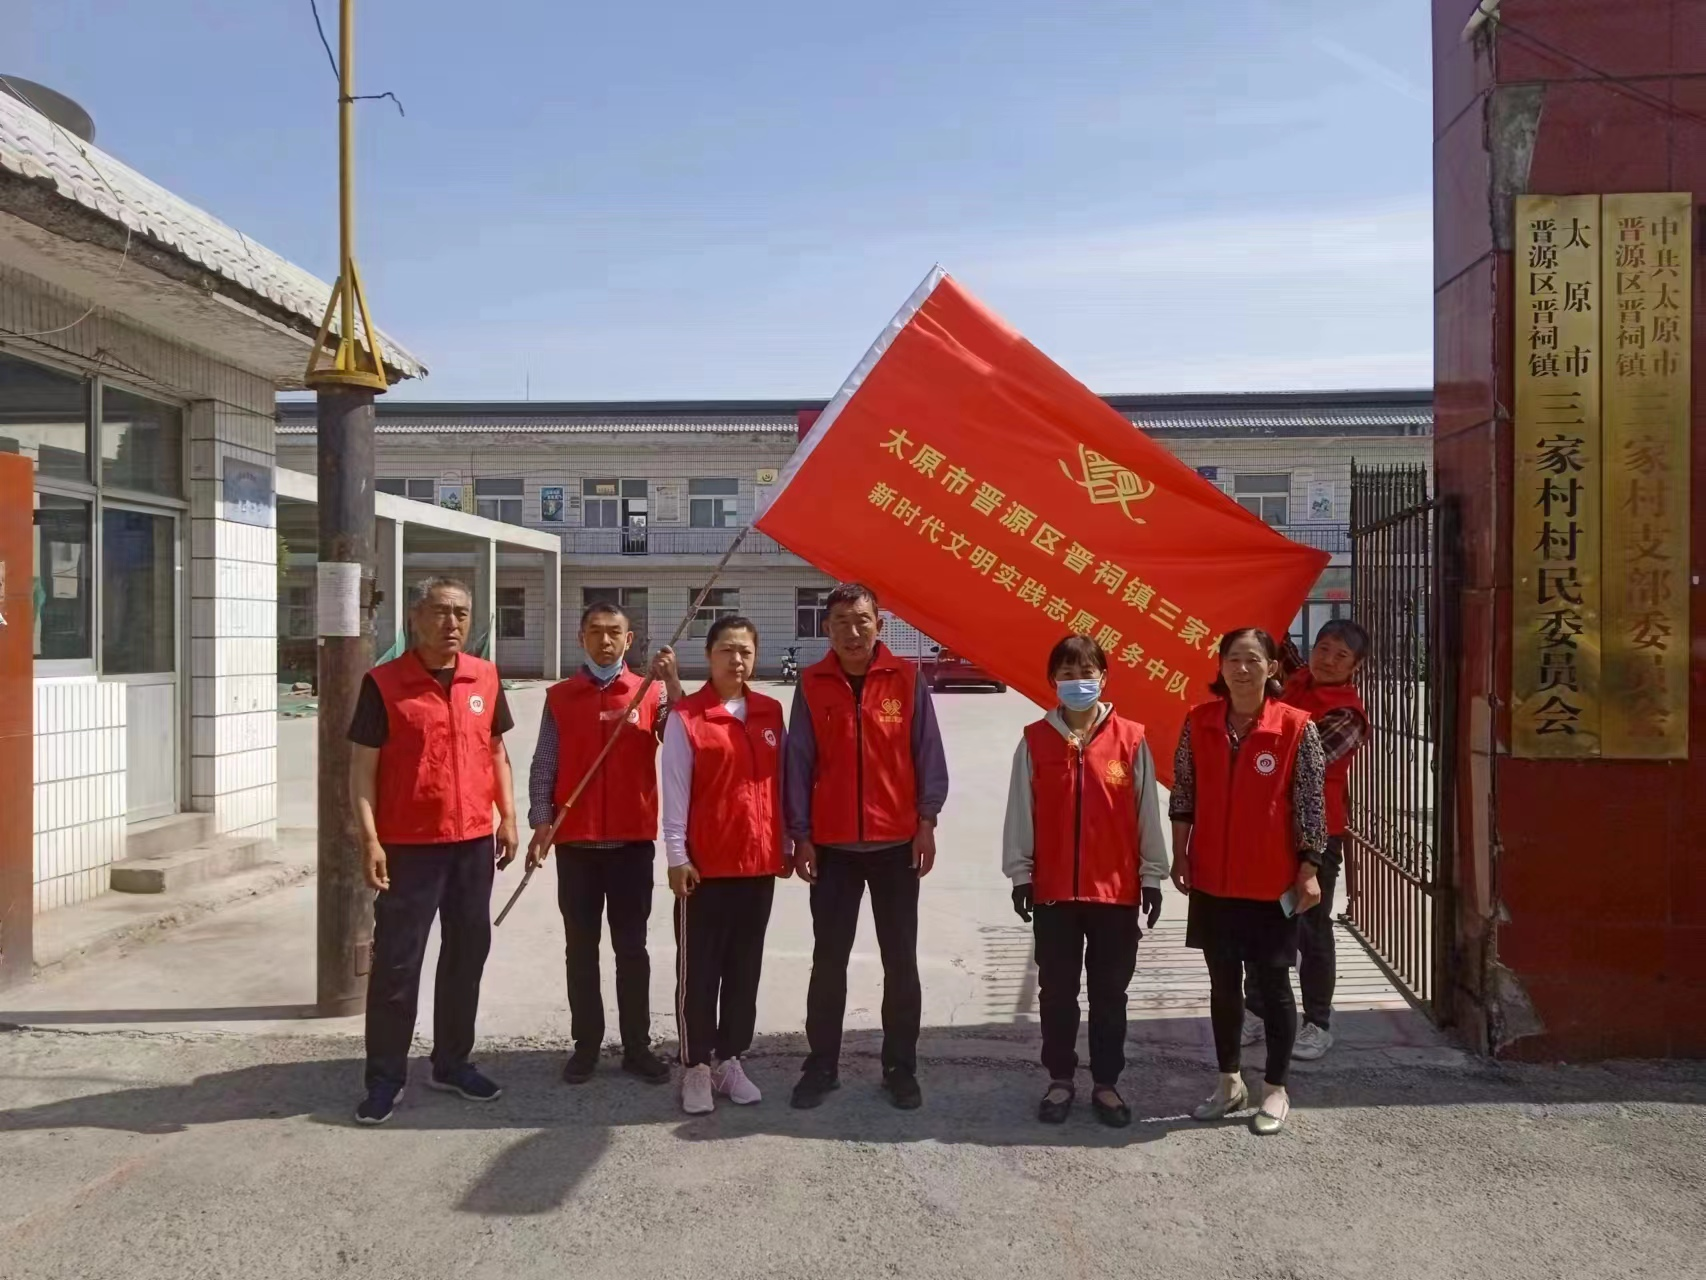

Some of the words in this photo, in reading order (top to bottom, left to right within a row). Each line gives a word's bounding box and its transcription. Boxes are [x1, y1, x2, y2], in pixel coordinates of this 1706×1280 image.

[1528, 219, 1560, 377] 晋源区晋祠镇
[1561, 217, 1592, 377] 太原市
[1615, 216, 1649, 377] 晋源区晋祠镇
[1650, 215, 1682, 377] 中共太原市
[867, 481, 1190, 701] 新时代文明实践志愿服务中队
[1533, 391, 1585, 735] 三家村村民委员会
